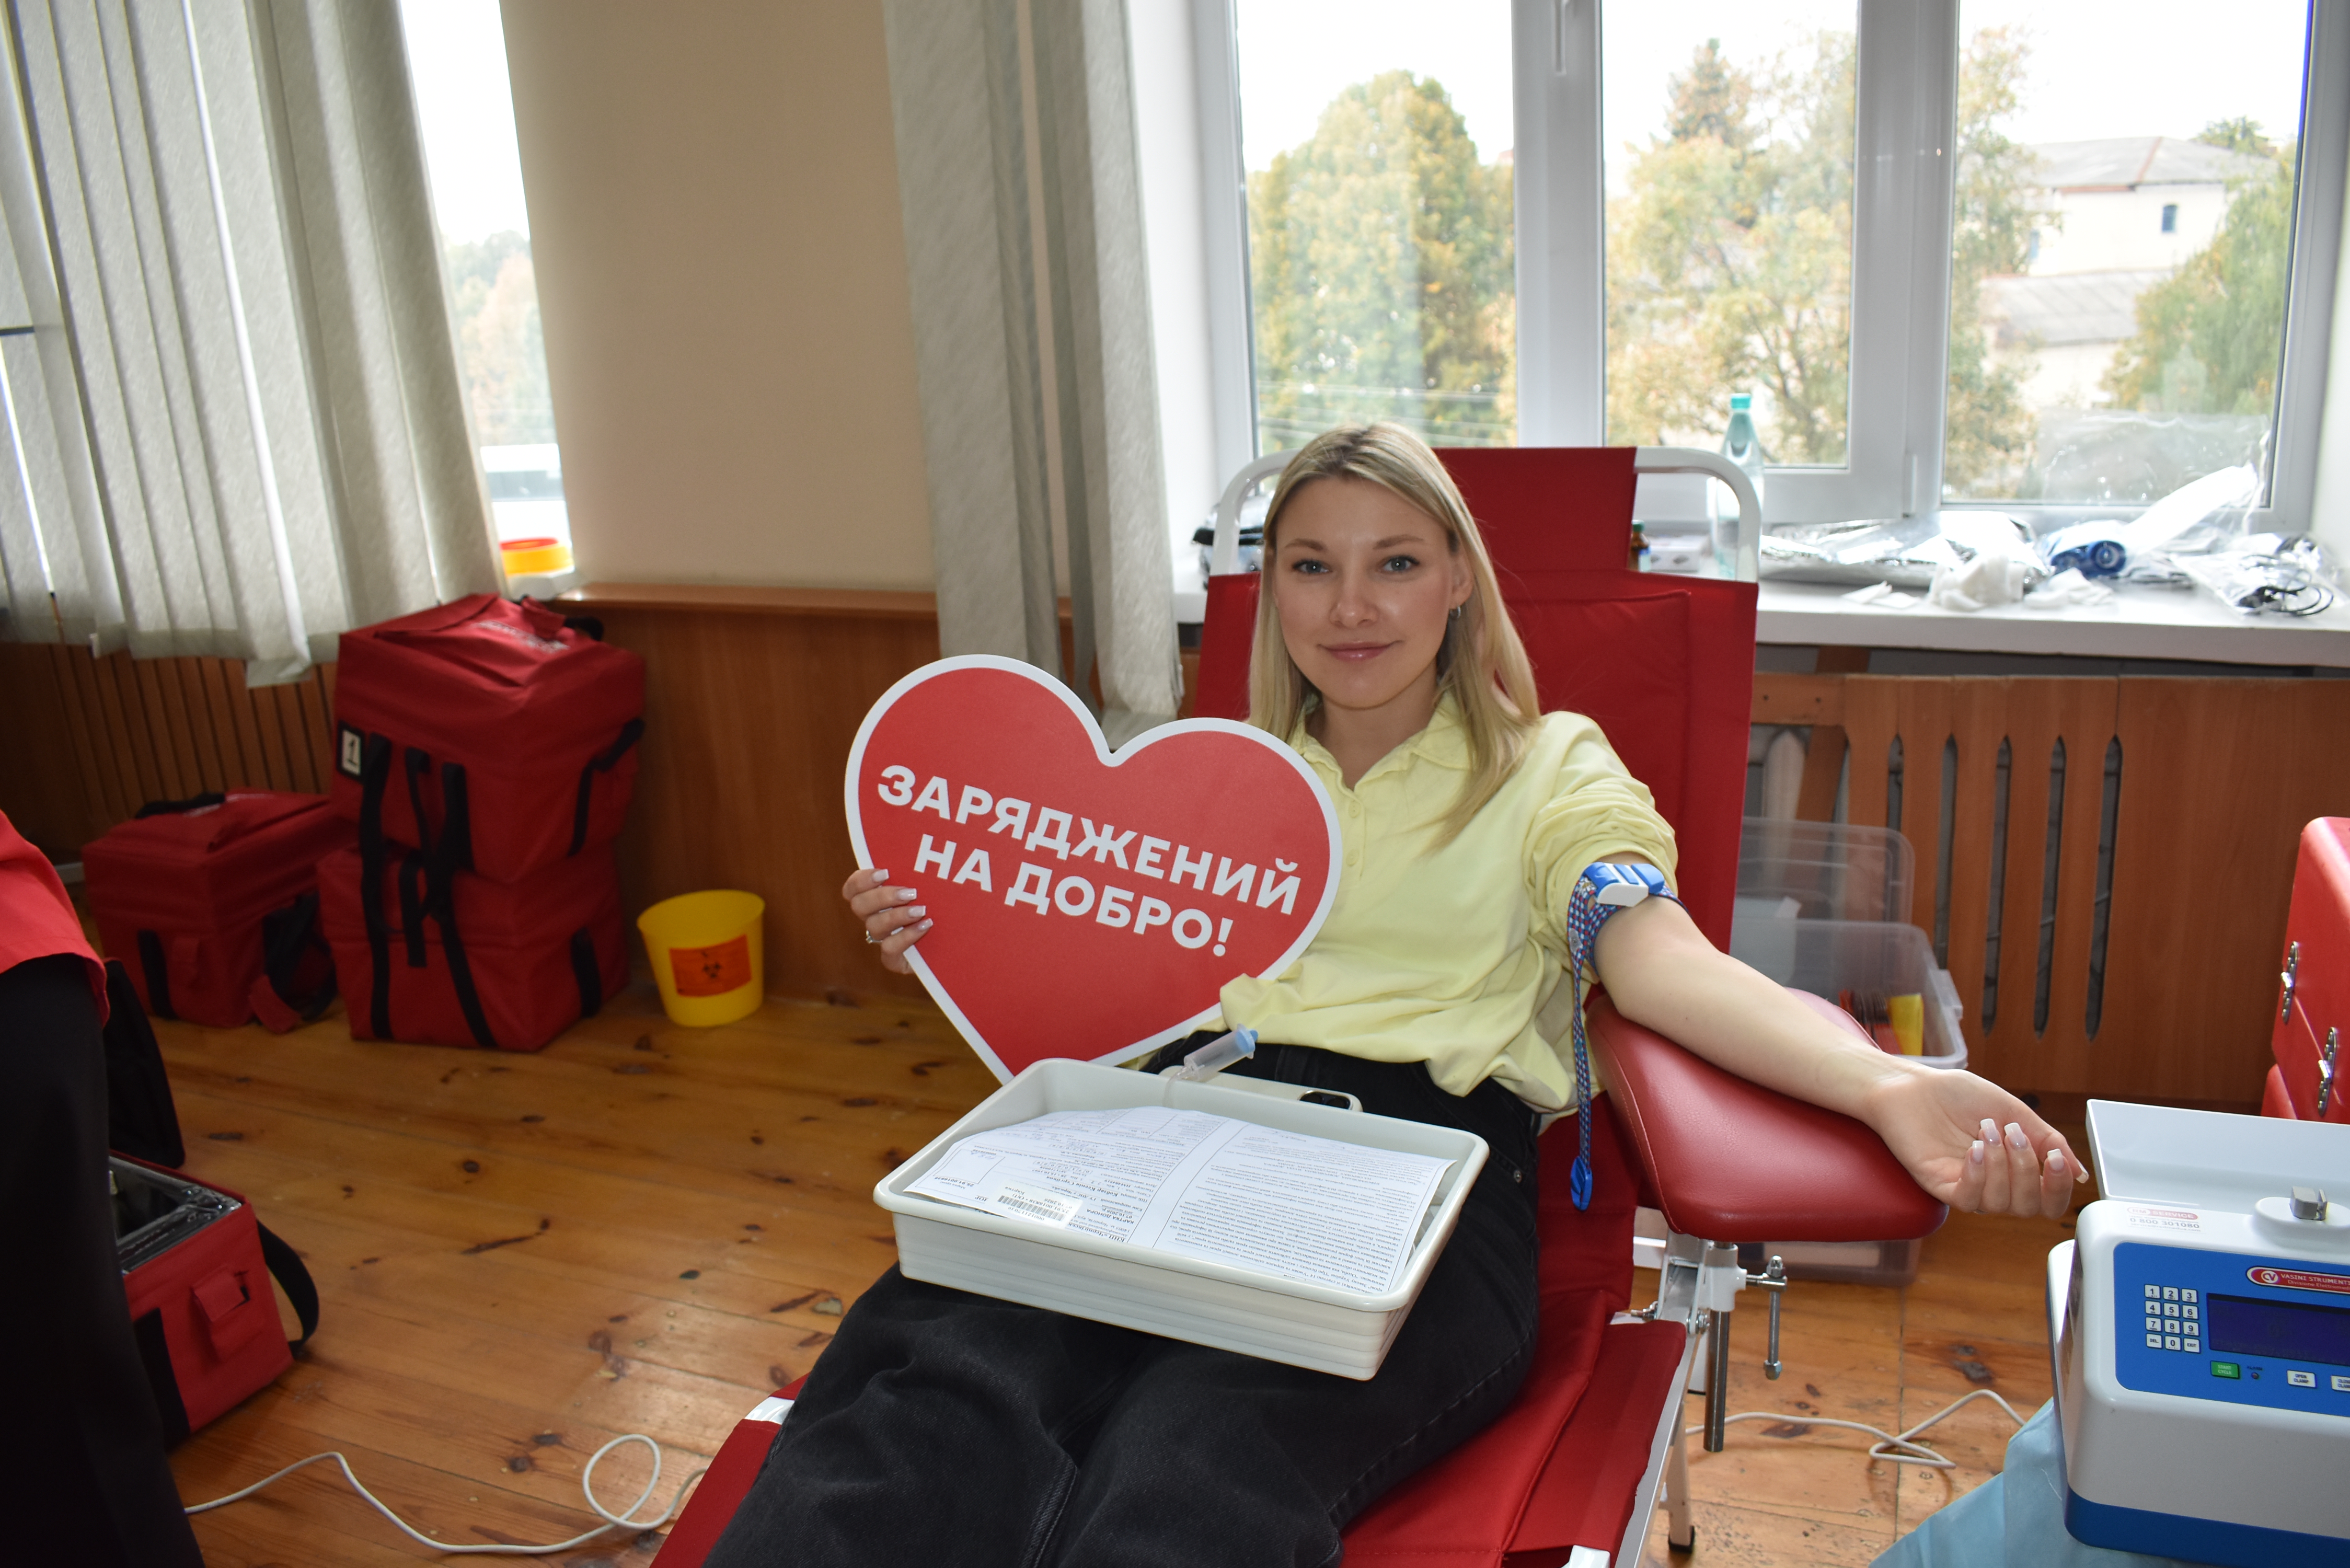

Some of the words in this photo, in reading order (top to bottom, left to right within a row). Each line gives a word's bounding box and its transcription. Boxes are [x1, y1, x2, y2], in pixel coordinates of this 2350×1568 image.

[877, 764, 1302, 916] ЗАРЯДЖЕНИЙ
[913, 834, 993, 893] НА
[1004, 862, 1234, 956] ДОБРО!
[2152, 1210, 2194, 1219] SERVICE
